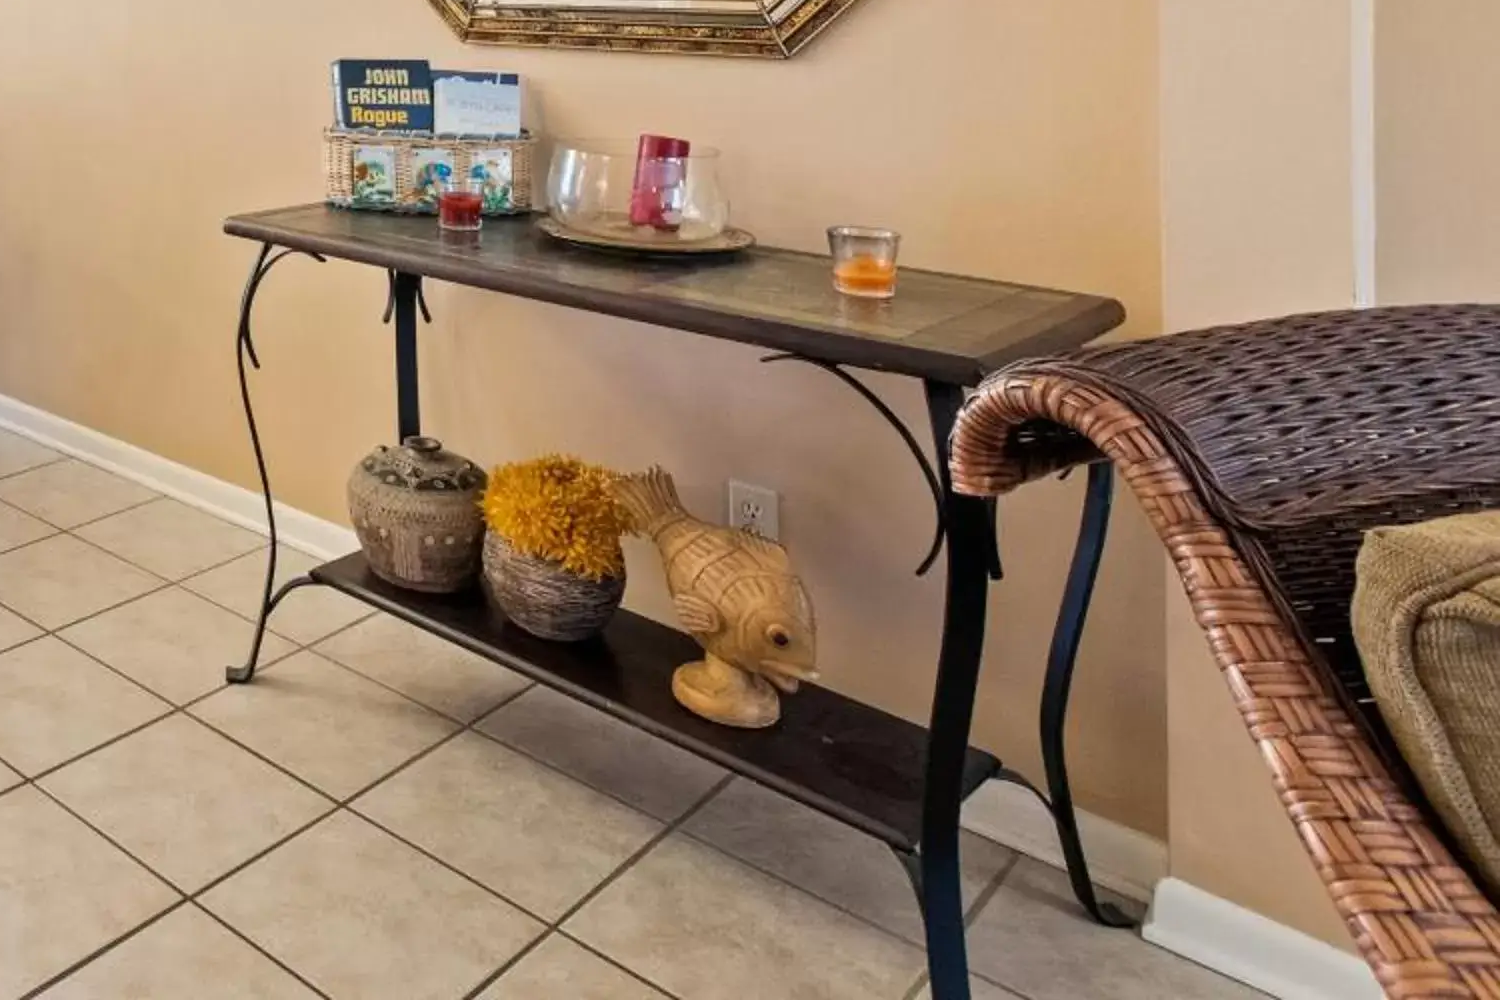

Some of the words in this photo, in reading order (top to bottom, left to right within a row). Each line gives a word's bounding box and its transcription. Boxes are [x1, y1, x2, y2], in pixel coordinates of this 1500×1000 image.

[365, 68, 408, 86] JOHN
[347, 87, 430, 105] GRISHAM
[351, 106, 408, 127] Rogue
